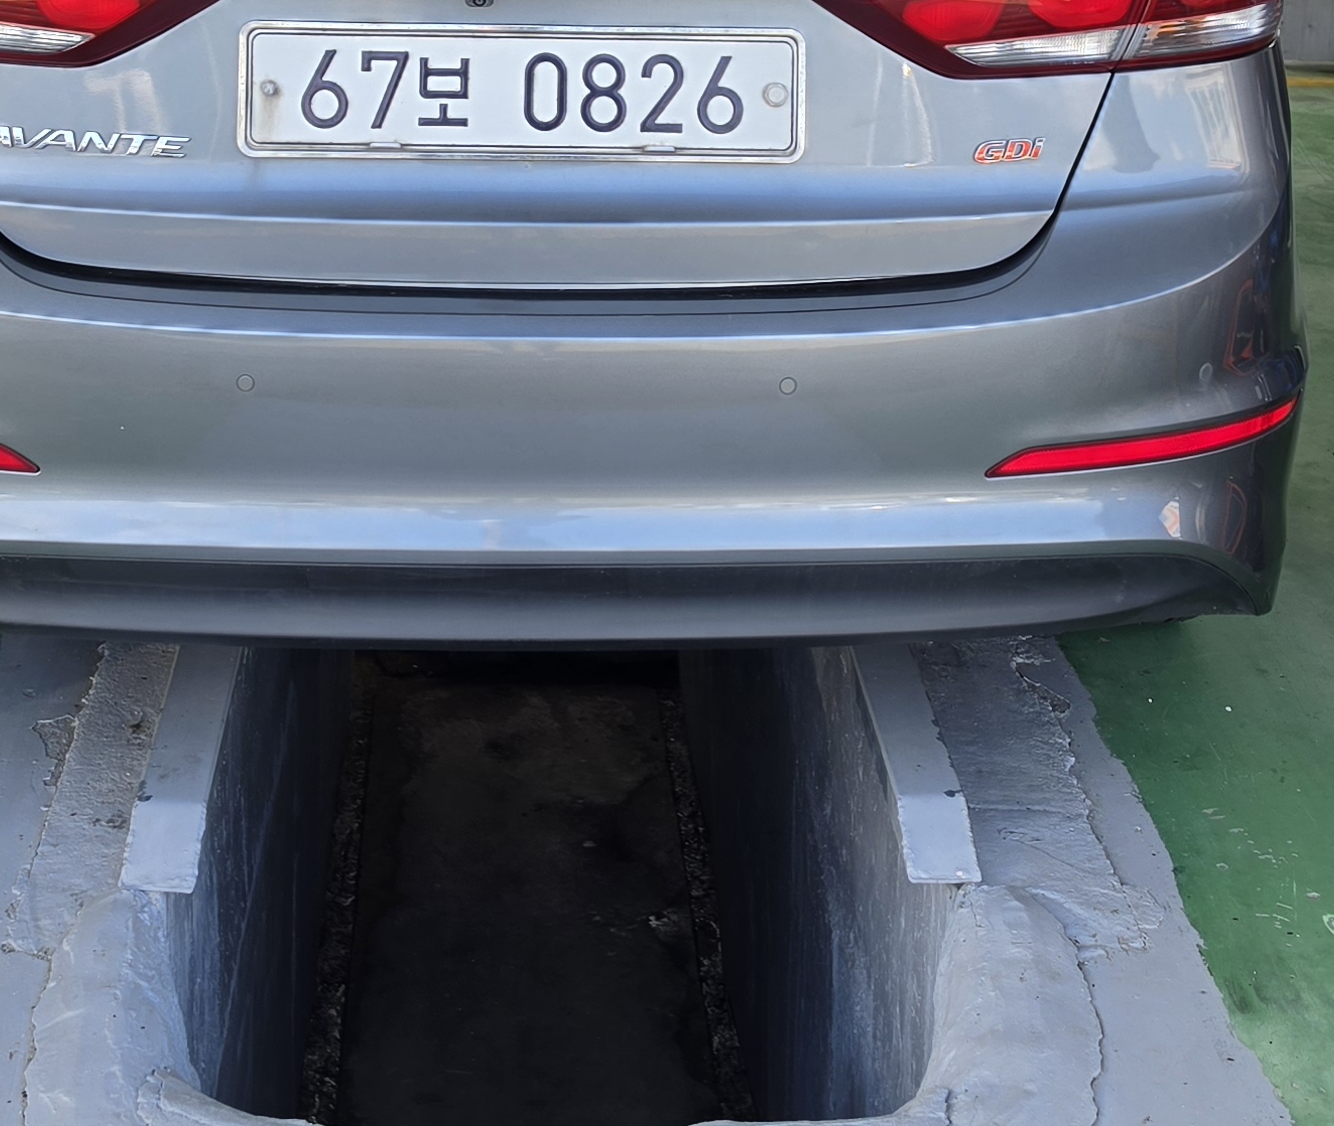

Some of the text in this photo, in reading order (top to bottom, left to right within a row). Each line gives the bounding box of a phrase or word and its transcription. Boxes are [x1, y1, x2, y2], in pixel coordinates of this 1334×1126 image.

[300, 49, 745, 134] 67보 0826
[973, 137, 1046, 164] GDi
